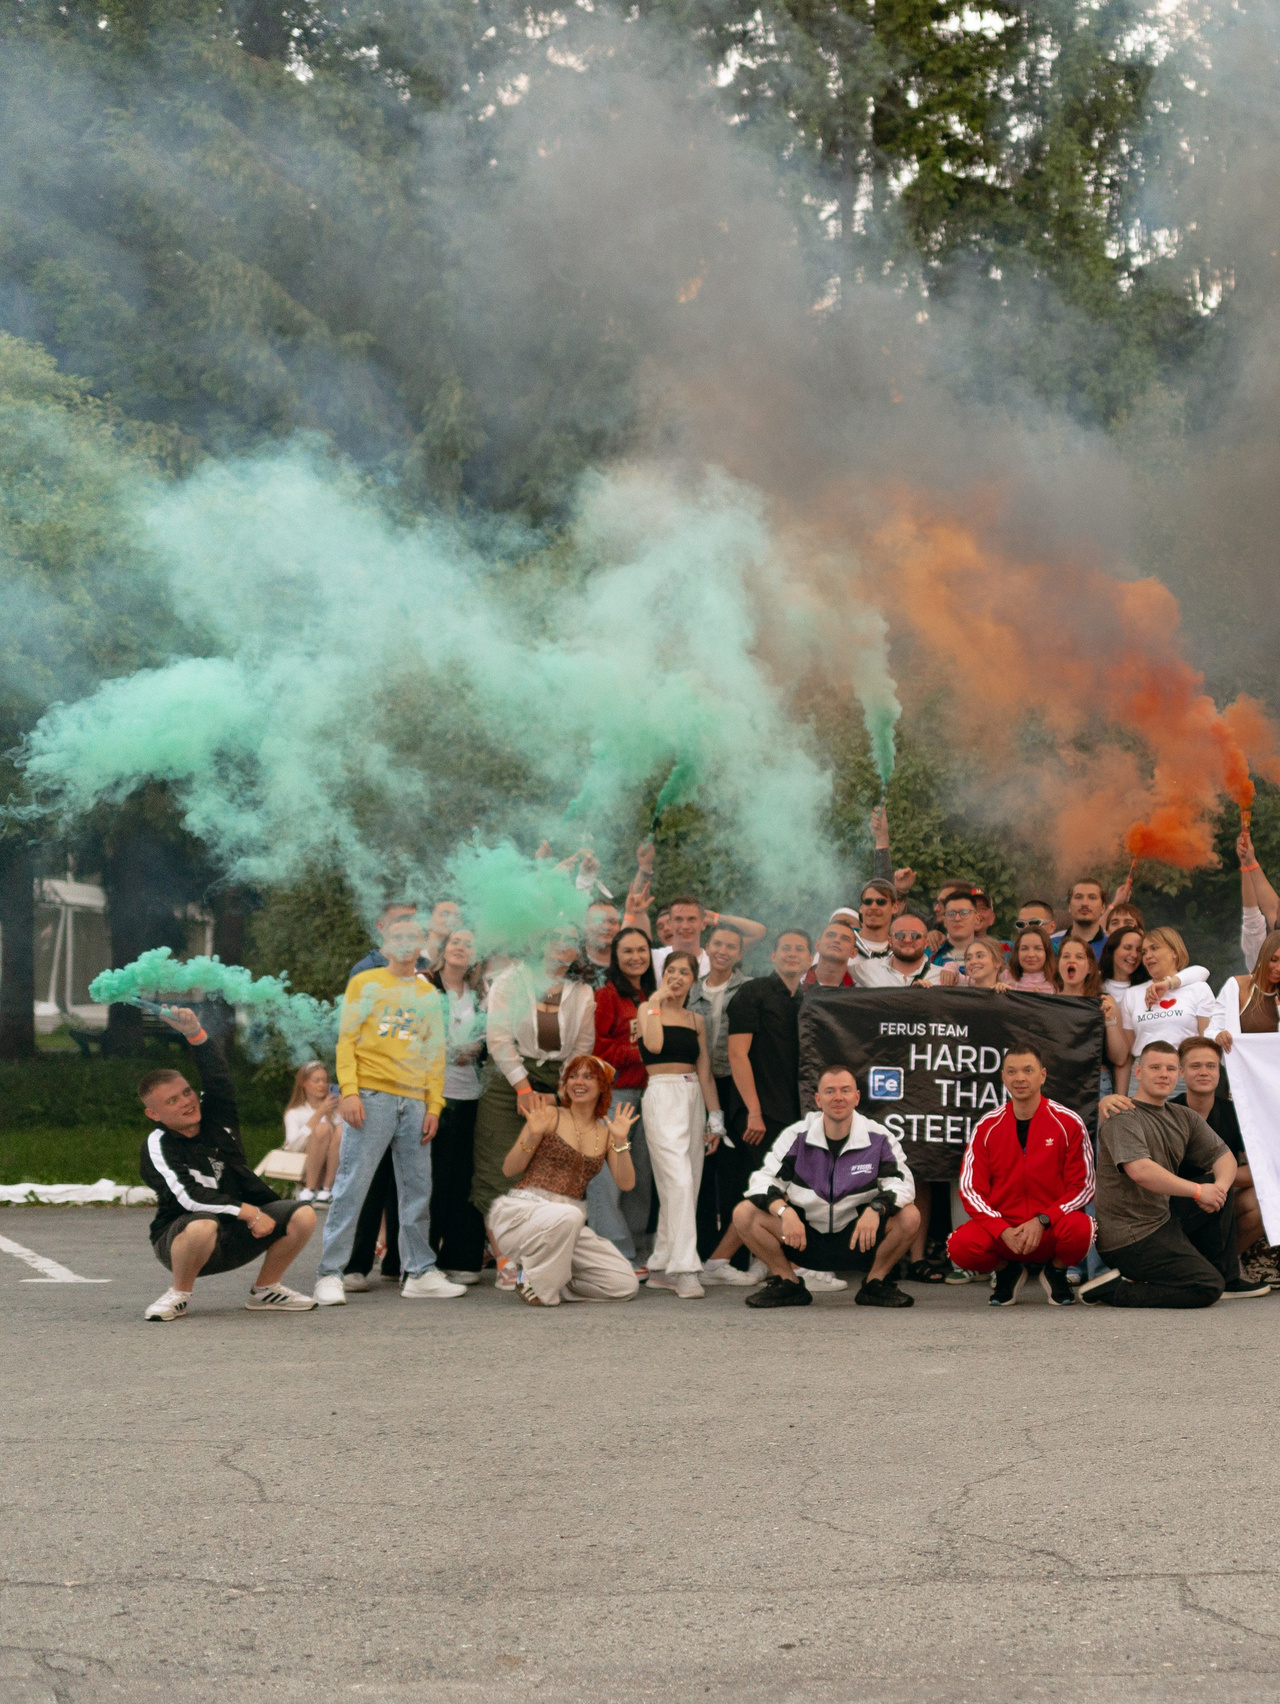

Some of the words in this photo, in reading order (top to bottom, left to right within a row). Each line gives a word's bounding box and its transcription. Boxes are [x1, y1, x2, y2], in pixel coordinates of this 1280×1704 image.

[1137, 1009, 1184, 1023] MOSCOW
[880, 1022, 926, 1036] FERUS
[929, 1022, 969, 1038] TEAM
[910, 1043, 1009, 1073] HARD
[873, 1074, 899, 1093] Fe
